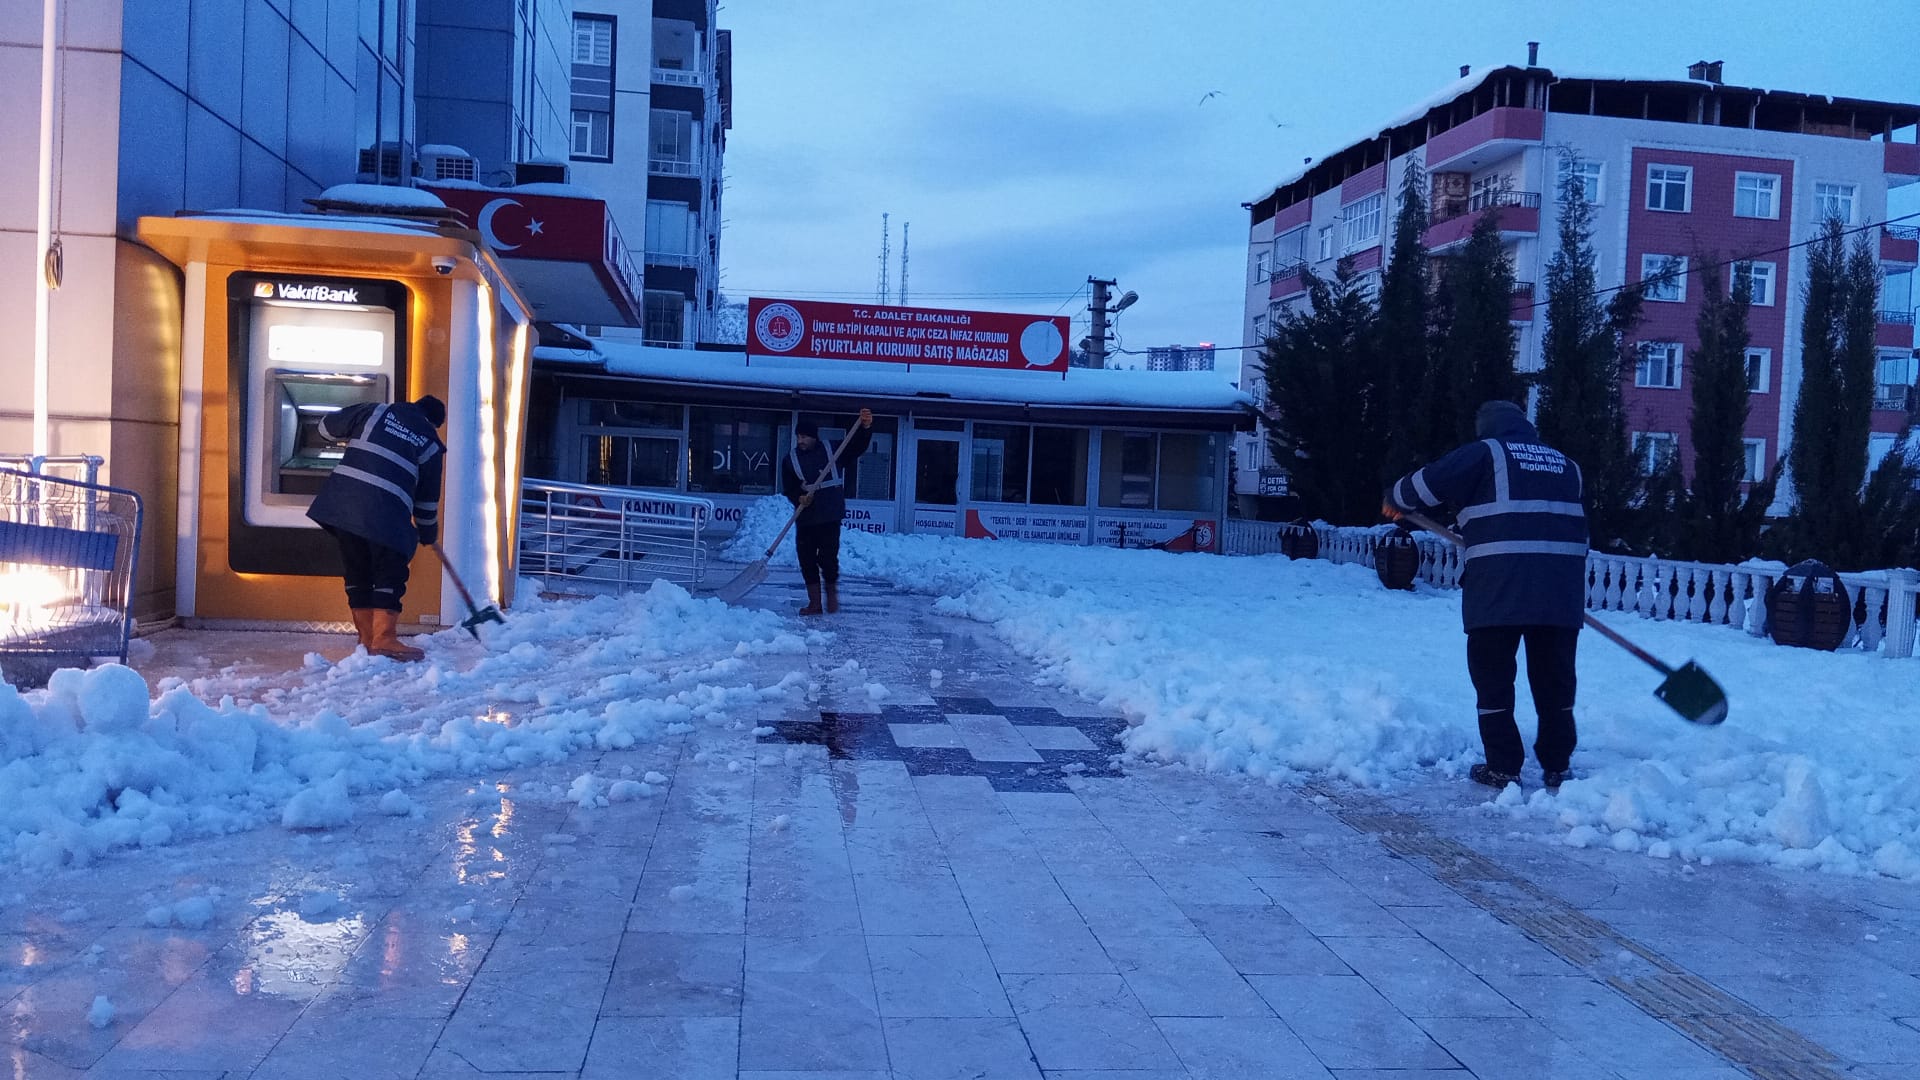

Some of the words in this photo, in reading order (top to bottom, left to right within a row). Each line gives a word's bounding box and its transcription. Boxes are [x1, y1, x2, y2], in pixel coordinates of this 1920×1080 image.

[853, 309, 871, 319] T.C.
[874, 311, 913, 321] ADALET
[916, 312, 971, 325] BAKANLIĞI
[812, 319, 835, 333] ÜNYE
[837, 321, 861, 335] M-TİPİ
[864, 324, 892, 337] KAPALI
[894, 326, 905, 338] VE
[906, 327, 926, 341] AÇIK
[927, 328, 948, 341] CEZA
[950, 327, 973, 342] İNFAZ
[974, 331, 1009, 344] KURUMU
[811, 334, 873, 355] İŞYURTLARI
[876, 341, 921, 357] KURUMU
[924, 344, 953, 363] SATIŞ
[956, 345, 1009, 363] MAĞAZASI
[844, 509, 871, 520] GIDA
